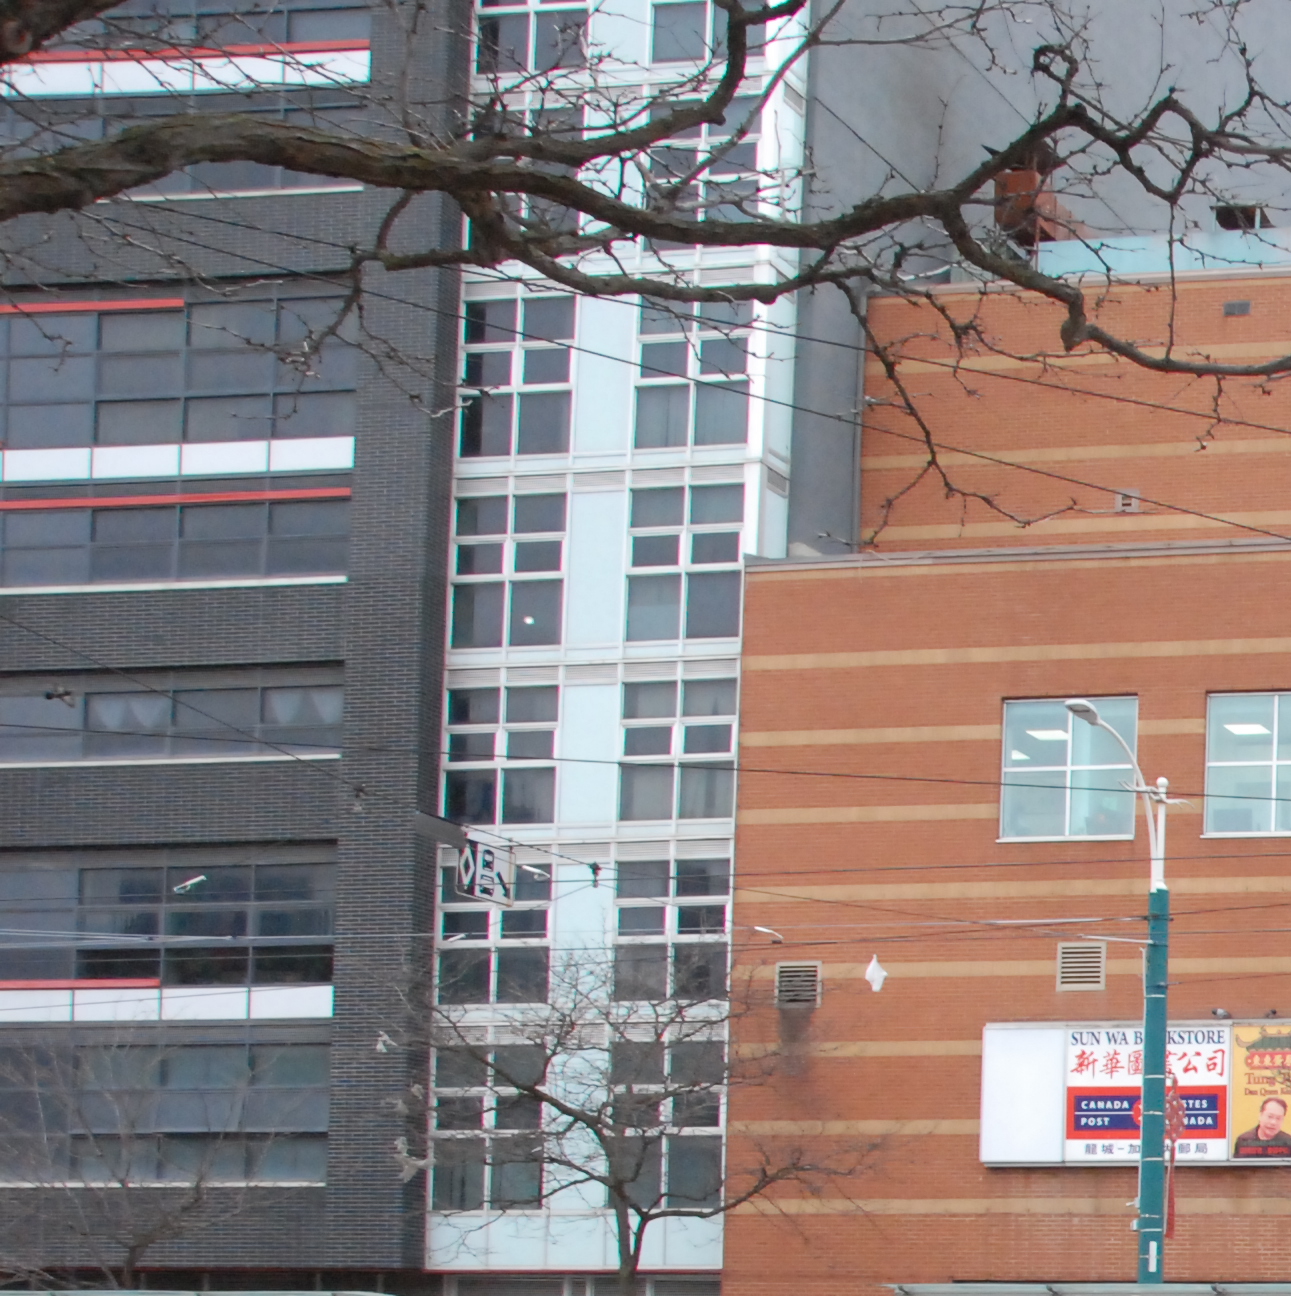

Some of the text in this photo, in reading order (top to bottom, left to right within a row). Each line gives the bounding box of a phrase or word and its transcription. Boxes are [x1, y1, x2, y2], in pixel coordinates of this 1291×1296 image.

[1071, 1030, 1226, 1046] SUN WA BKSTORE
[1081, 1100, 1130, 1110] CANADA
[1080, 1117, 1111, 1127] POST
